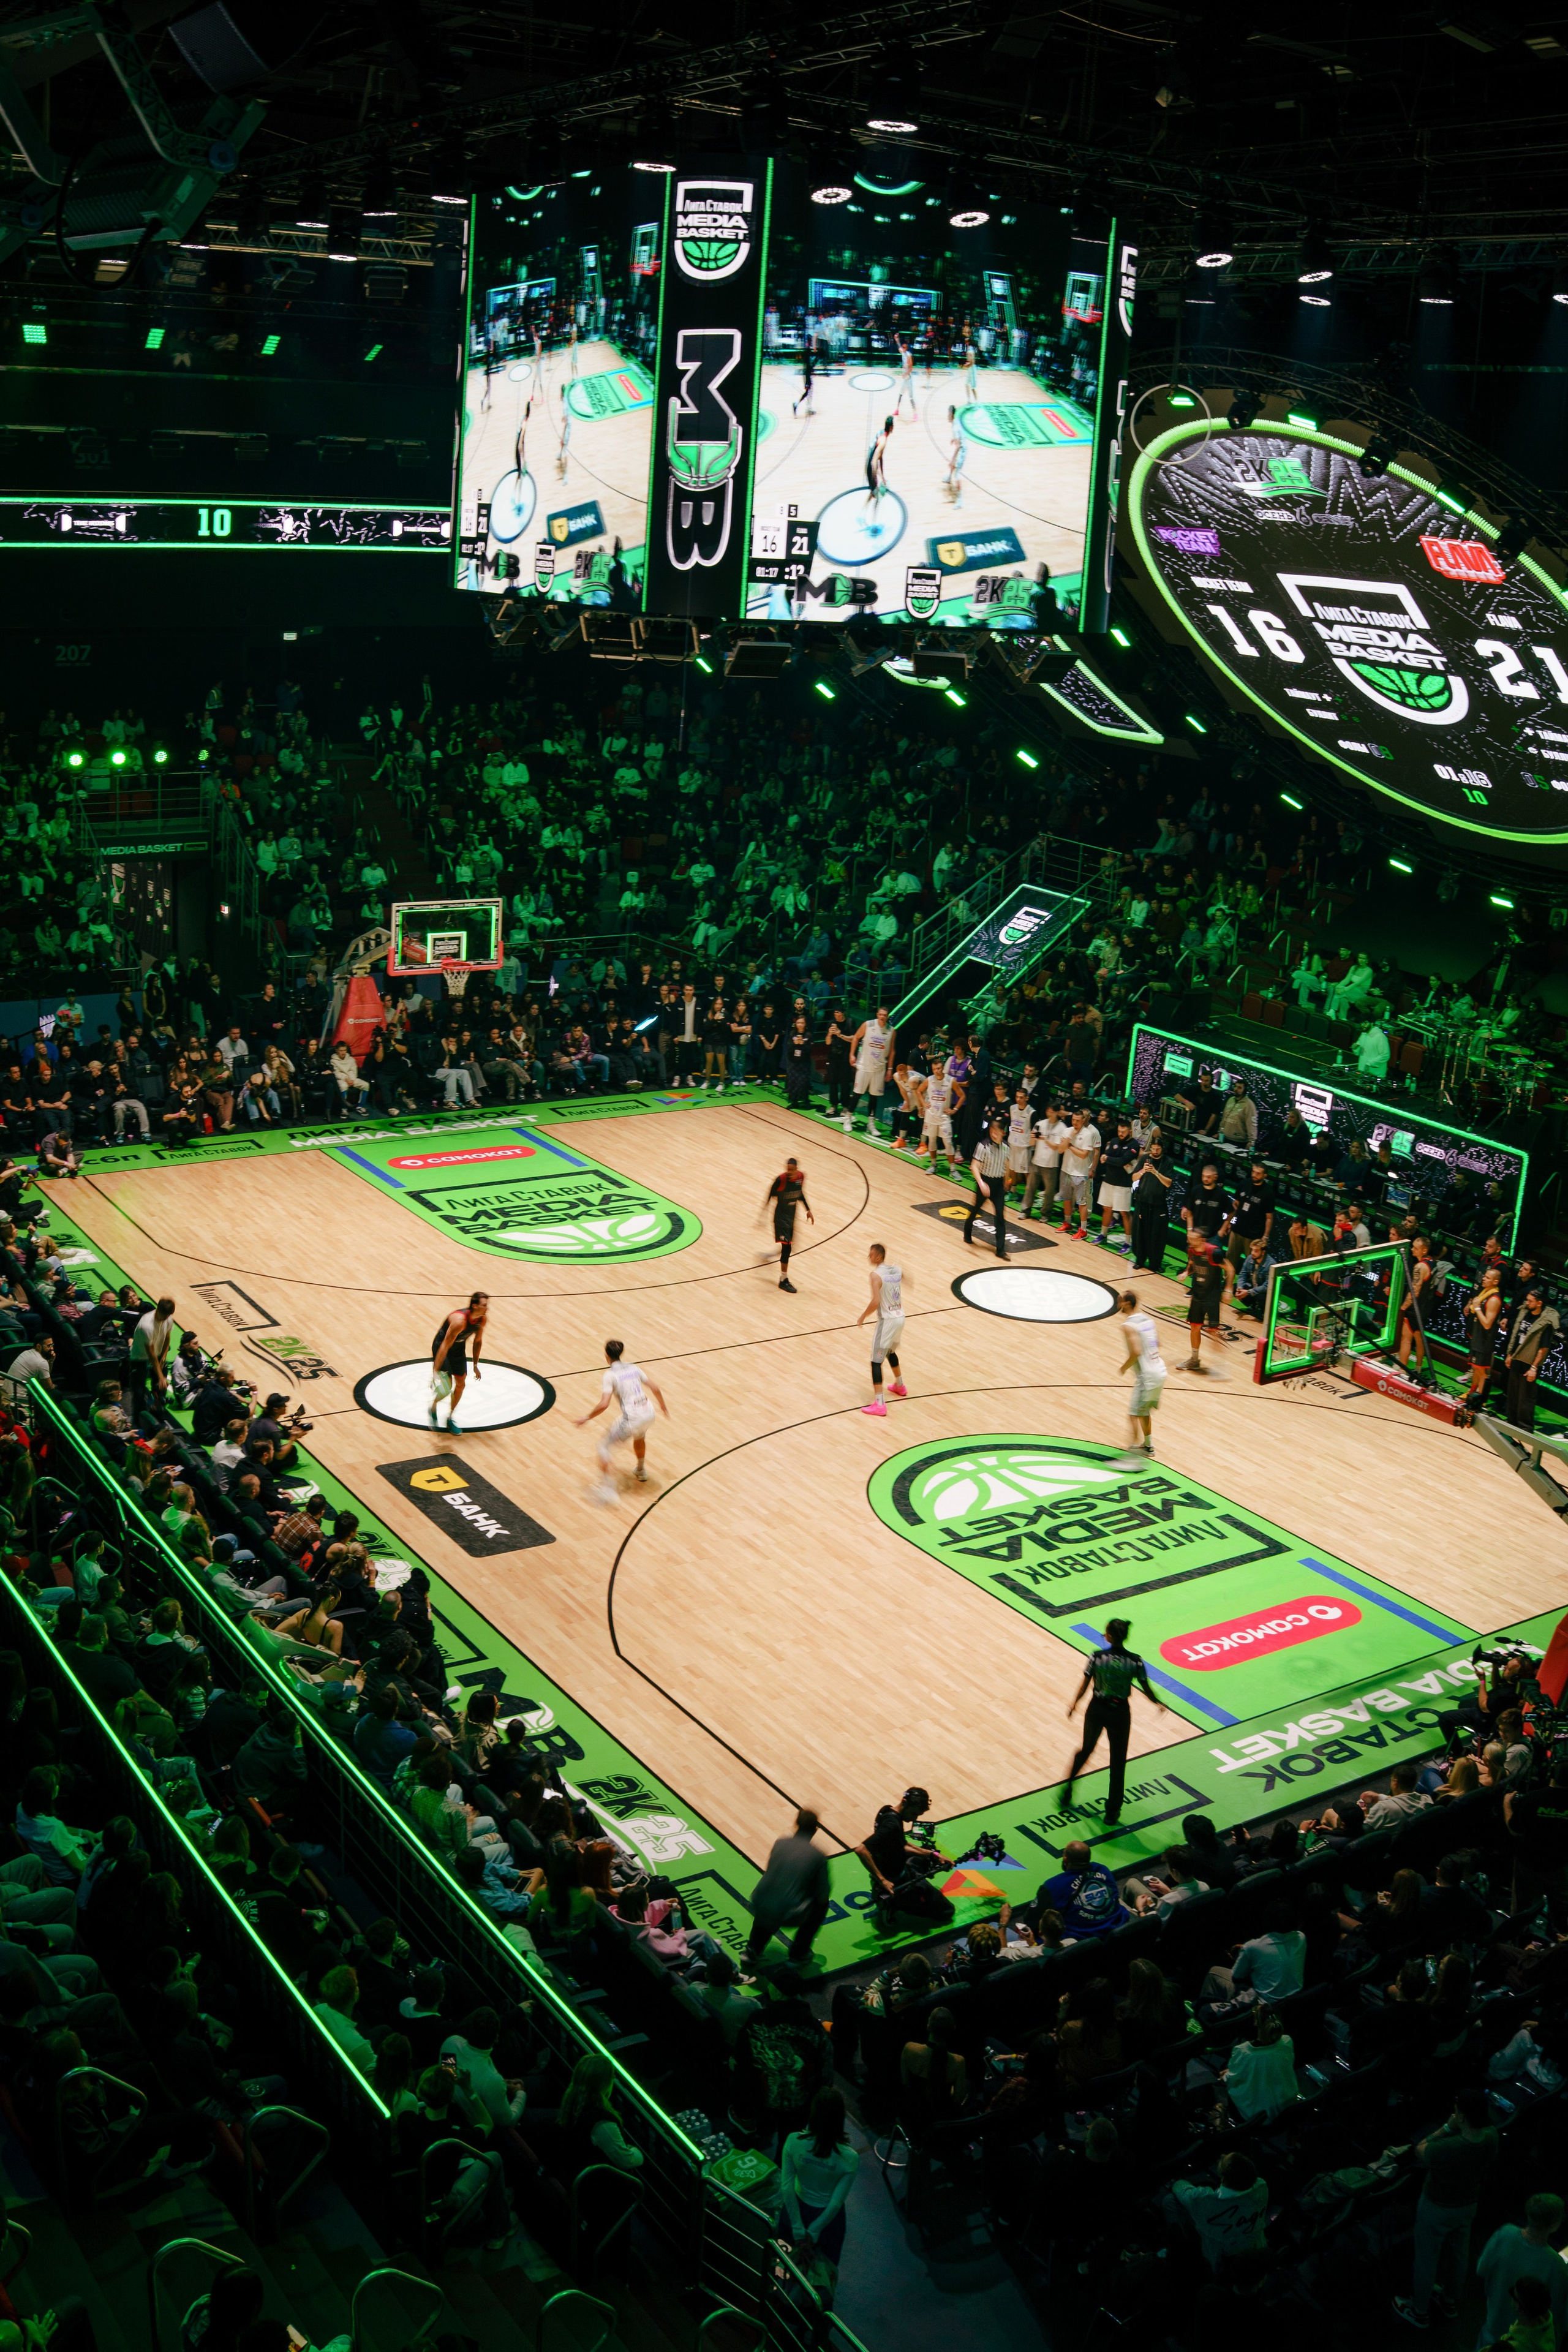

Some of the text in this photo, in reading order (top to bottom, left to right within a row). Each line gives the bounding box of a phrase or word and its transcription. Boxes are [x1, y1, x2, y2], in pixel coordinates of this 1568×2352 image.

[676, 228, 748, 239] BASKET
[677, 214, 748, 228] MEDIA
[1231, 456, 1312, 488] 2K25
[197, 508, 219, 537] 10
[790, 506, 797, 516] 5
[1256, 509, 1296, 521] ОСЕНЬ
[762, 534, 777, 553] 16
[791, 535, 810, 556] 21
[1156, 529, 1217, 545] ROCKET
[1170, 539, 1218, 554] TEAM
[973, 575, 1034, 609] 2K25
[1206, 605, 1306, 663] 16
[1485, 613, 1523, 630] FLAVA
[1312, 622, 1443, 655] MEDIA
[55, 644, 92, 661] 207
[1325, 641, 1448, 671] BASKET
[1474, 639, 1568, 704] 21
[1433, 763, 1493, 789] 01:16
[1461, 788, 1489, 806] 10
[100, 843, 184, 856] MEDIA BASKET
[705, 1090, 755, 1099] сбп
[1295, 1102, 1329, 1118] MEDIA
[287, 1108, 529, 1140] ЛИГА СТАВОК
[288, 1114, 540, 1148] MEDIA BASKET
[84, 1152, 141, 1165] сбп
[426, 1148, 524, 1165] самокат
[1415, 1142, 1446, 1159] ОСЕНЬ
[1444, 1148, 1458, 1167] 6
[437, 1193, 651, 1225] MEDIA
[454, 1200, 659, 1235] BASKET
[972, 1219, 1027, 1244] БАК
[257, 1335, 344, 1381] 2K25
[1387, 1385, 1430, 1410] самокат
[441, 1491, 511, 1539] БАНК
[938, 1476, 1182, 1548] BASKET
[951, 1491, 1219, 1563] MEDIA
[1180, 1611, 1311, 1663] самокат
[1208, 1689, 1414, 1774] BASKET
[1237, 1706, 1442, 1793] СТАВОК
[573, 1773, 717, 1863] 2K25
